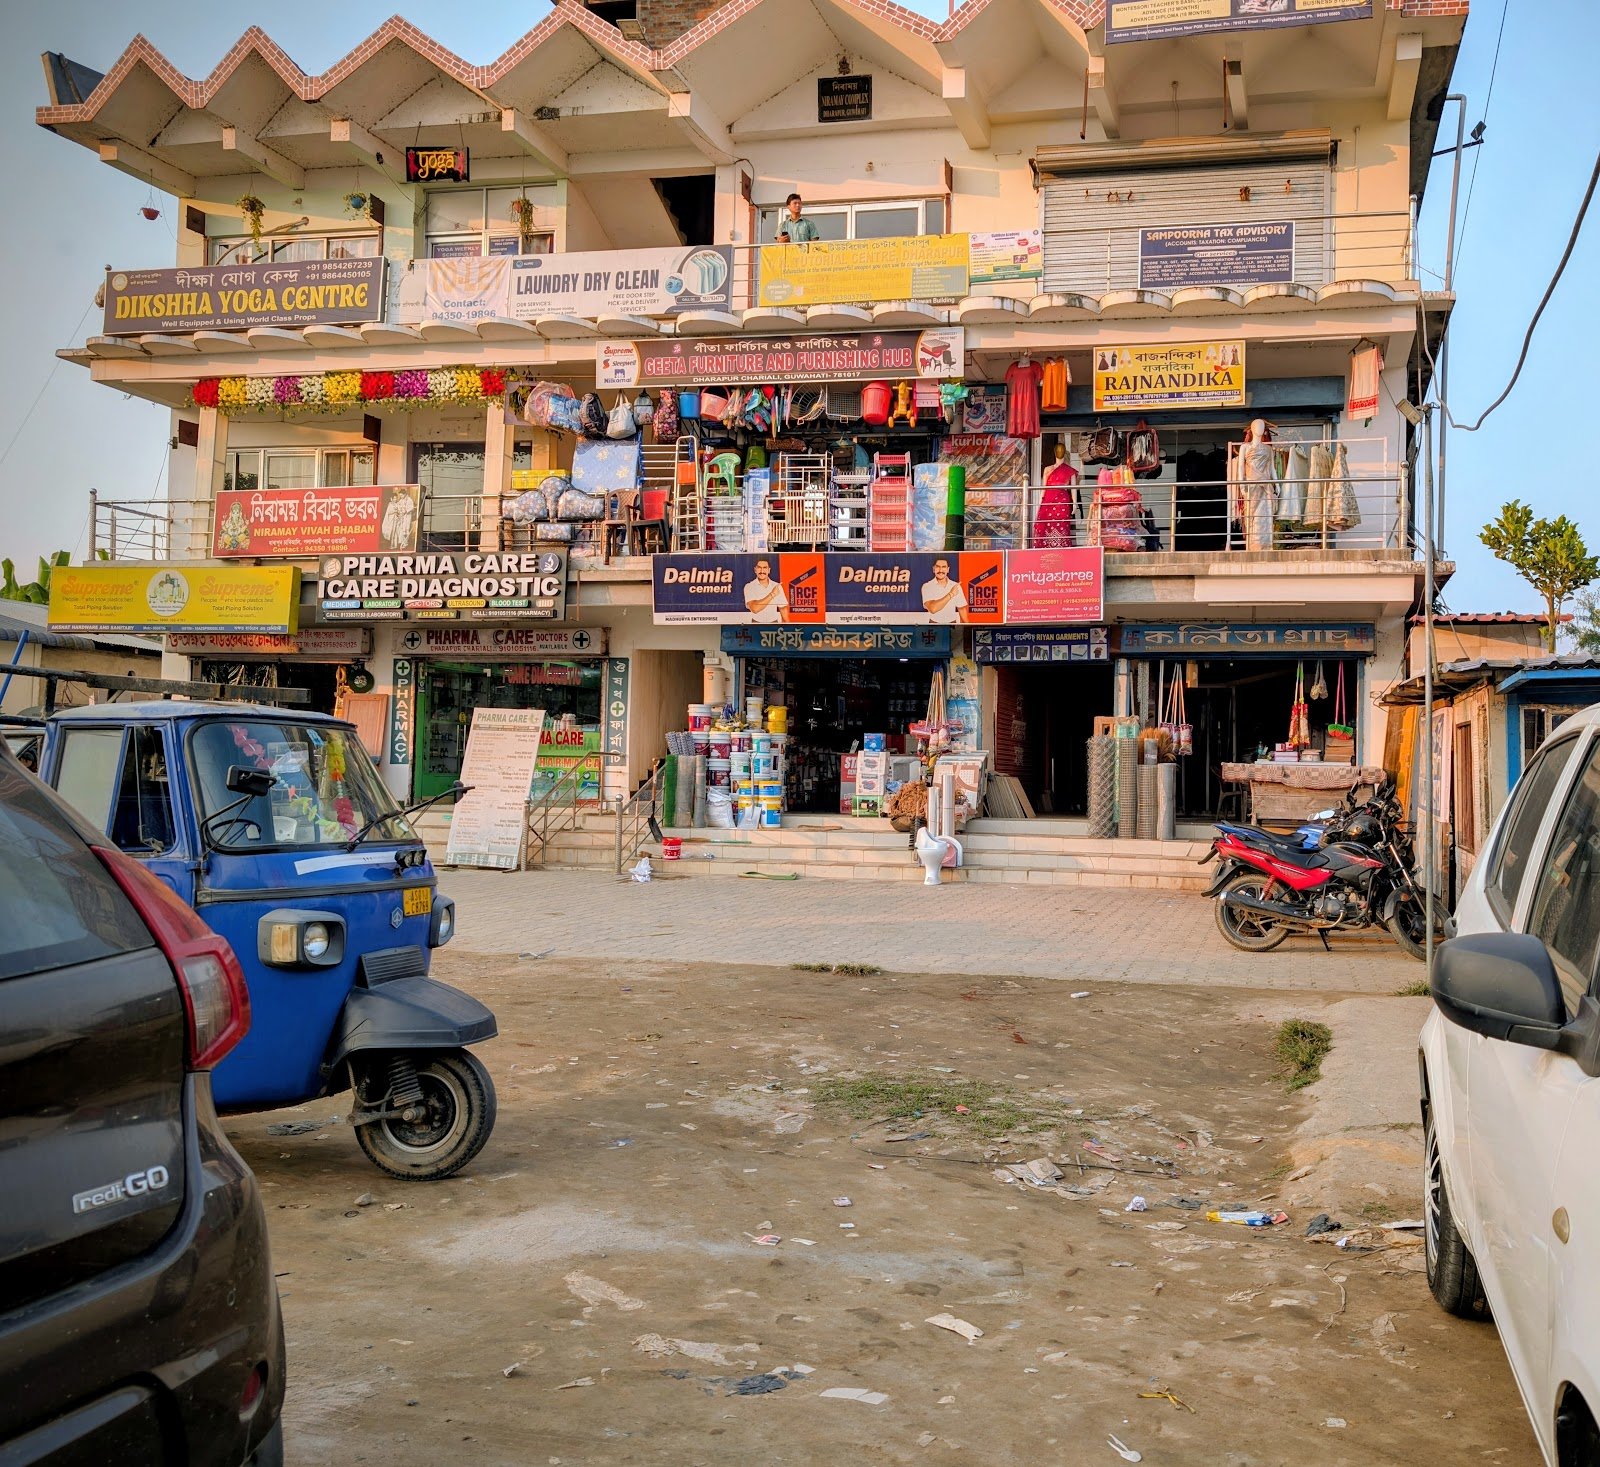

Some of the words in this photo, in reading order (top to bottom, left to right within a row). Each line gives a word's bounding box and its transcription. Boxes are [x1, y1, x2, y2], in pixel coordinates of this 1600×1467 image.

[416, 151, 455, 179] yoga
[1147, 229, 1211, 241] SAMPOORNA
[1214, 228, 1234, 238] TAX
[1236, 225, 1288, 237] ADVISORY
[1228, 236, 1268, 244] COMPLIANCES)
[794, 254, 848, 266] TUTORIAL
[852, 250, 899, 263] CENTRE,
[903, 247, 964, 260] DHARAPUR
[306, 263, 321, 271] +91
[322, 261, 373, 270] 9854267239
[176, 270, 215, 290] দীক্ষা
[221, 270, 257, 287] যোগ
[305, 272, 320, 280] +91
[321, 270, 371, 279] 9864450105
[516, 273, 580, 295] LAUNDRY
[584, 271, 612, 292] DRY
[615, 268, 660, 290] CLEAN
[115, 292, 214, 319] DIKSHHA
[218, 288, 278, 315] YOGA
[282, 283, 369, 310] CENTRE
[443, 299, 486, 308] Contact:
[162, 320, 178, 328] Well
[179, 318, 215, 328] Equipped
[223, 317, 246, 326] Using
[247, 315, 270, 324] World
[271, 314, 292, 322] Class
[294, 313, 317, 323] Props
[604, 346, 634, 356] Supreme
[694, 343, 721, 353] গীতা
[612, 359, 637, 368] Sleepwell
[644, 357, 687, 376] GEETA
[688, 353, 764, 374] FURNITURE
[766, 351, 795, 372] AND
[797, 349, 880, 371] FURNISHING
[882, 347, 913, 367] HUB
[1142, 362, 1194, 373] राजनंदिका
[692, 375, 739, 383] DHARAPUR
[741, 374, 782, 382] CHARIALI,
[1105, 371, 1234, 393] RAJNANDIKA
[251, 492, 300, 523] নিৰাময়
[303, 491, 342, 523] বিবাহ
[254, 527, 298, 537] NIRAMAY
[301, 526, 331, 536] VIVAH
[333, 525, 375, 535] BHABAN
[343, 556, 457, 576] PHARMA
[464, 554, 536, 574] CARE
[664, 567, 734, 584] Dalmia
[839, 566, 911, 583] Dalmia
[1011, 570, 1094, 586] nrityashree
[61, 575, 134, 600] Supreme
[199, 575, 275, 601] Supreme
[401, 577, 559, 598] DIAGNOSTIC
[689, 585, 732, 594] cement
[797, 587, 818, 599] RCF
[865, 584, 909, 593] cement
[976, 586, 998, 598] RCF
[426, 630, 481, 645] PHARMA
[493, 630, 535, 645] CARE
[394, 678, 409, 763] PHARMACY
[477, 713, 507, 723] PHARMA
[509, 714, 528, 723] CARE
[556, 731, 584, 746] CARE
